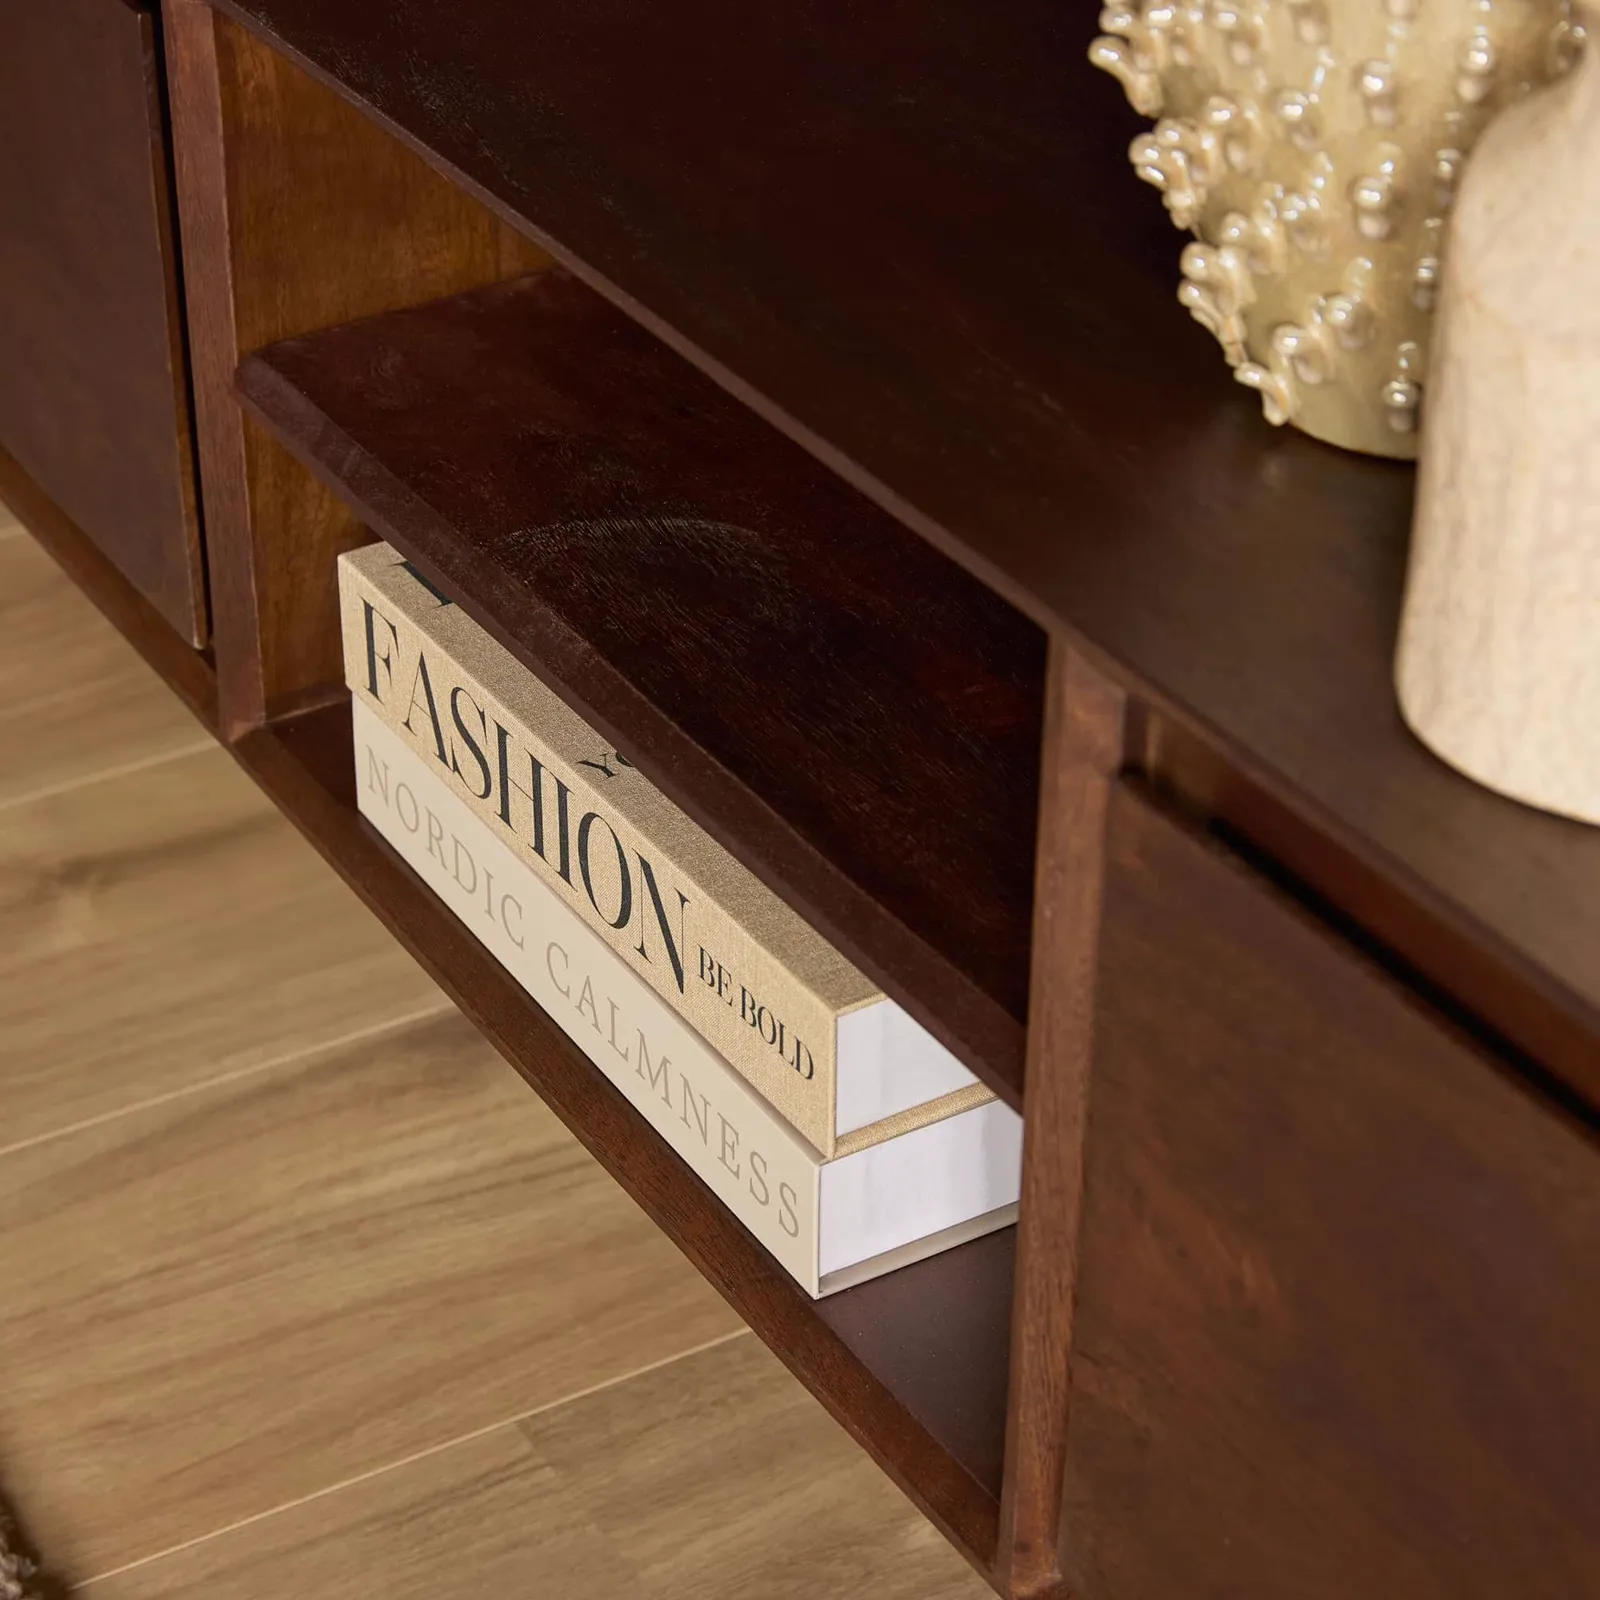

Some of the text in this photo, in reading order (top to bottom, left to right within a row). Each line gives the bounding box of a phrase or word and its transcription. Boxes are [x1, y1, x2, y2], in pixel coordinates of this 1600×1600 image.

[361, 596, 814, 1081] FASHION BE BOLD
[366, 744, 800, 1239] NORDIC CALMNESS
